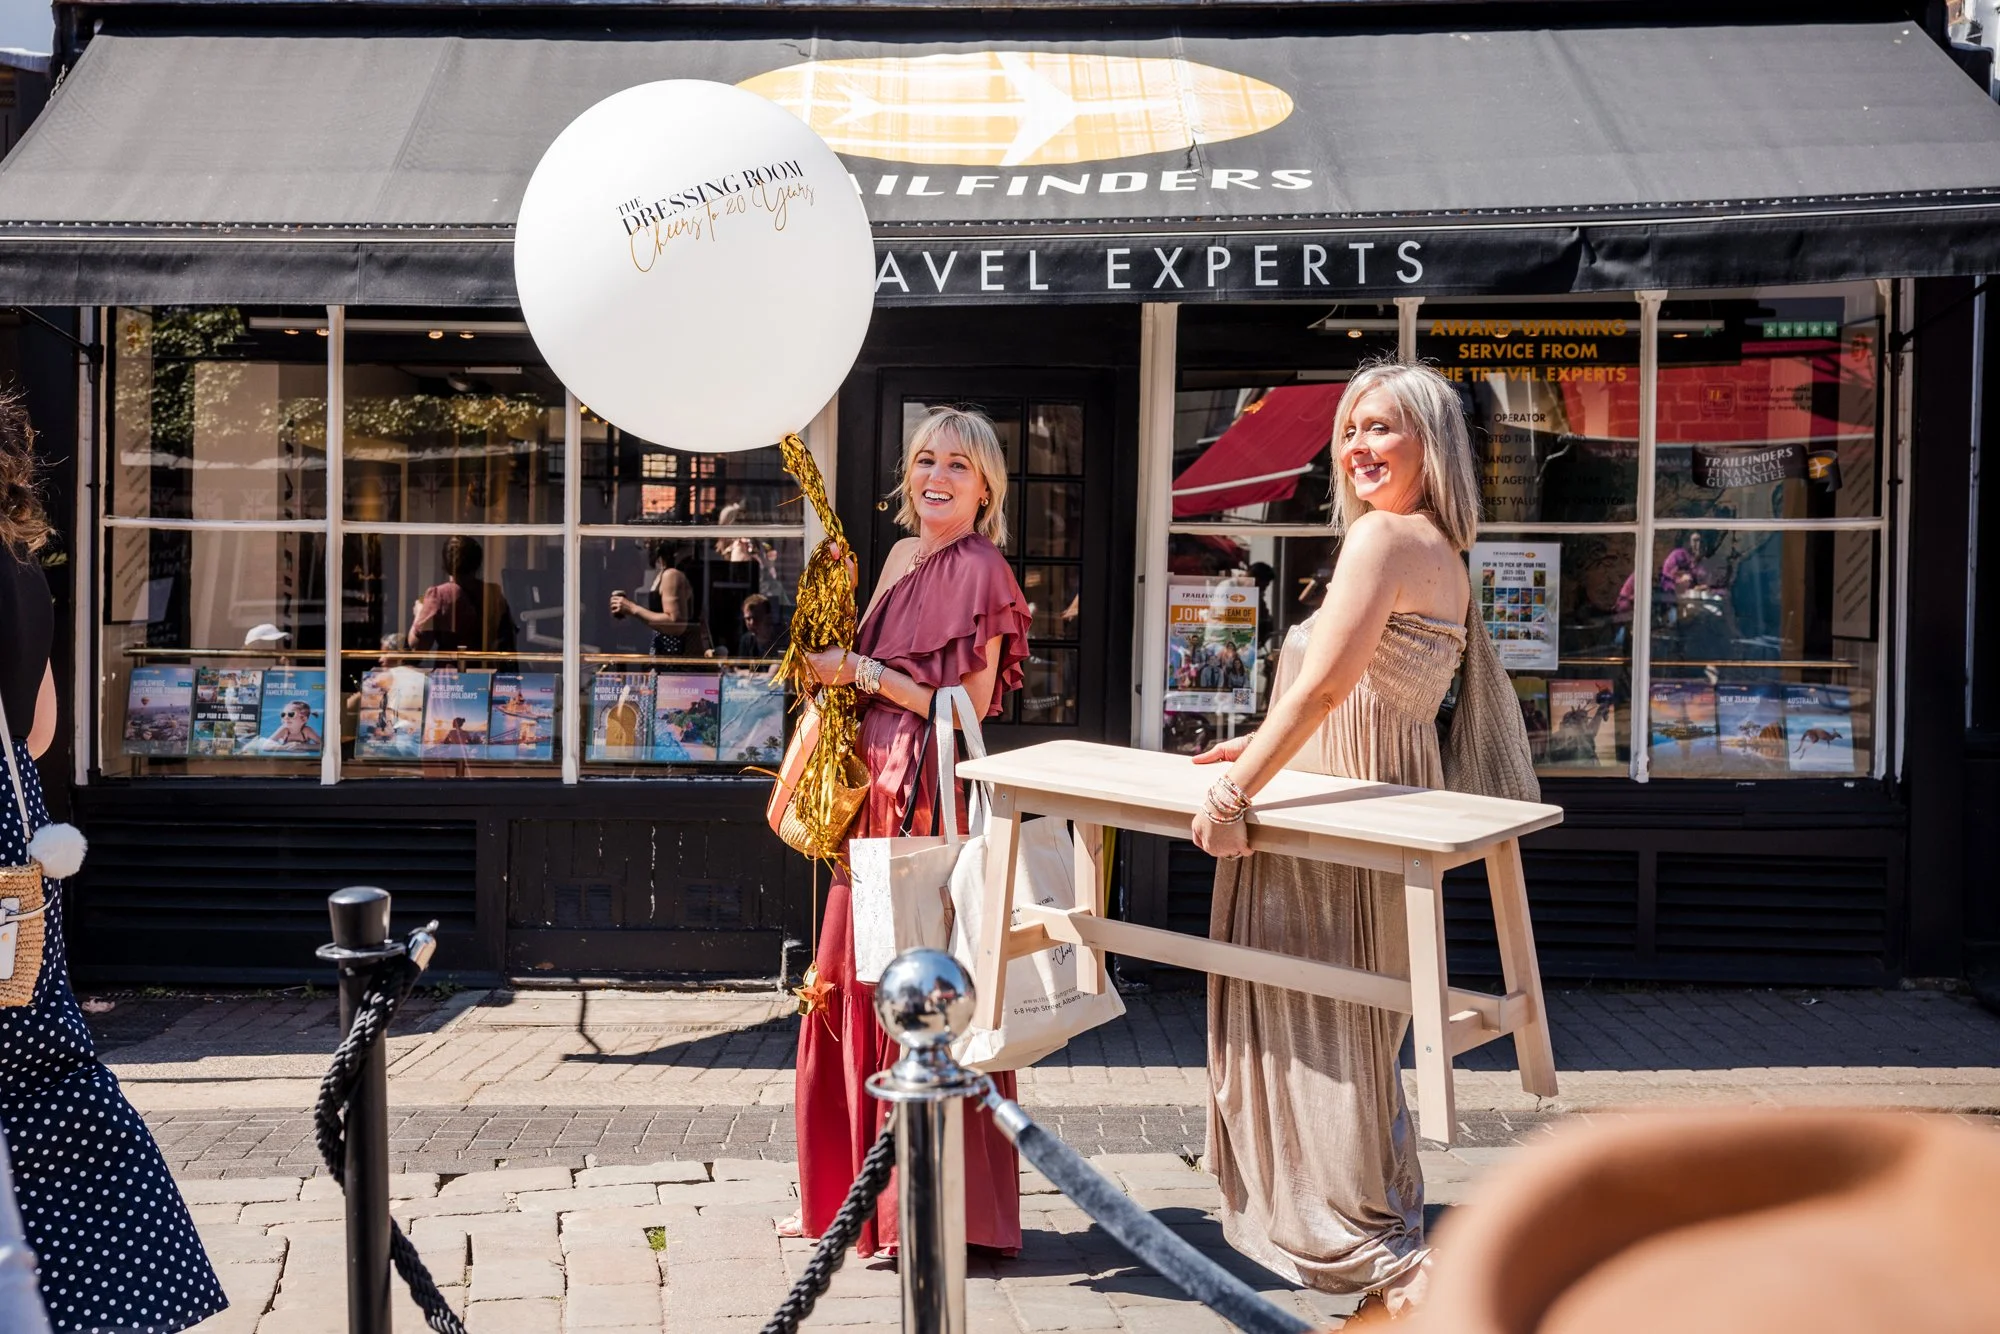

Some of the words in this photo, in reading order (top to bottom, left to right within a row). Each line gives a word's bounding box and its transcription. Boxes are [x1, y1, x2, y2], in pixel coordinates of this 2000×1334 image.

[849, 169, 1314, 196] ILFINDERS
[616, 196, 643, 216] THE
[623, 174, 741, 236] DRESSING
[742, 160, 804, 188] ROOM
[631, 215, 702, 272] Cheers
[726, 195, 746, 215] 20
[752, 180, 815, 231] Years
[875, 250, 1049, 293] AVEL
[1107, 240, 1424, 290] EXPERTS
[1430, 319, 1627, 336] AWARD-WINNING
[1459, 343, 1534, 359] SERVICE
[1541, 343, 1598, 359] FROM
[1469, 367, 1540, 382] TRAVEL
[1547, 367, 1627, 382] EXPERTS
[1494, 413, 1546, 422] OPERATOR
[1705, 447, 1793, 468] TRAILFINDERS
[1708, 460, 1784, 478] FINANCIAL
[1706, 471, 1786, 488] GUARANTEE
[1787, 697, 1819, 705] AUSTRALIA
[1025, 1006, 1040, 1014] High
